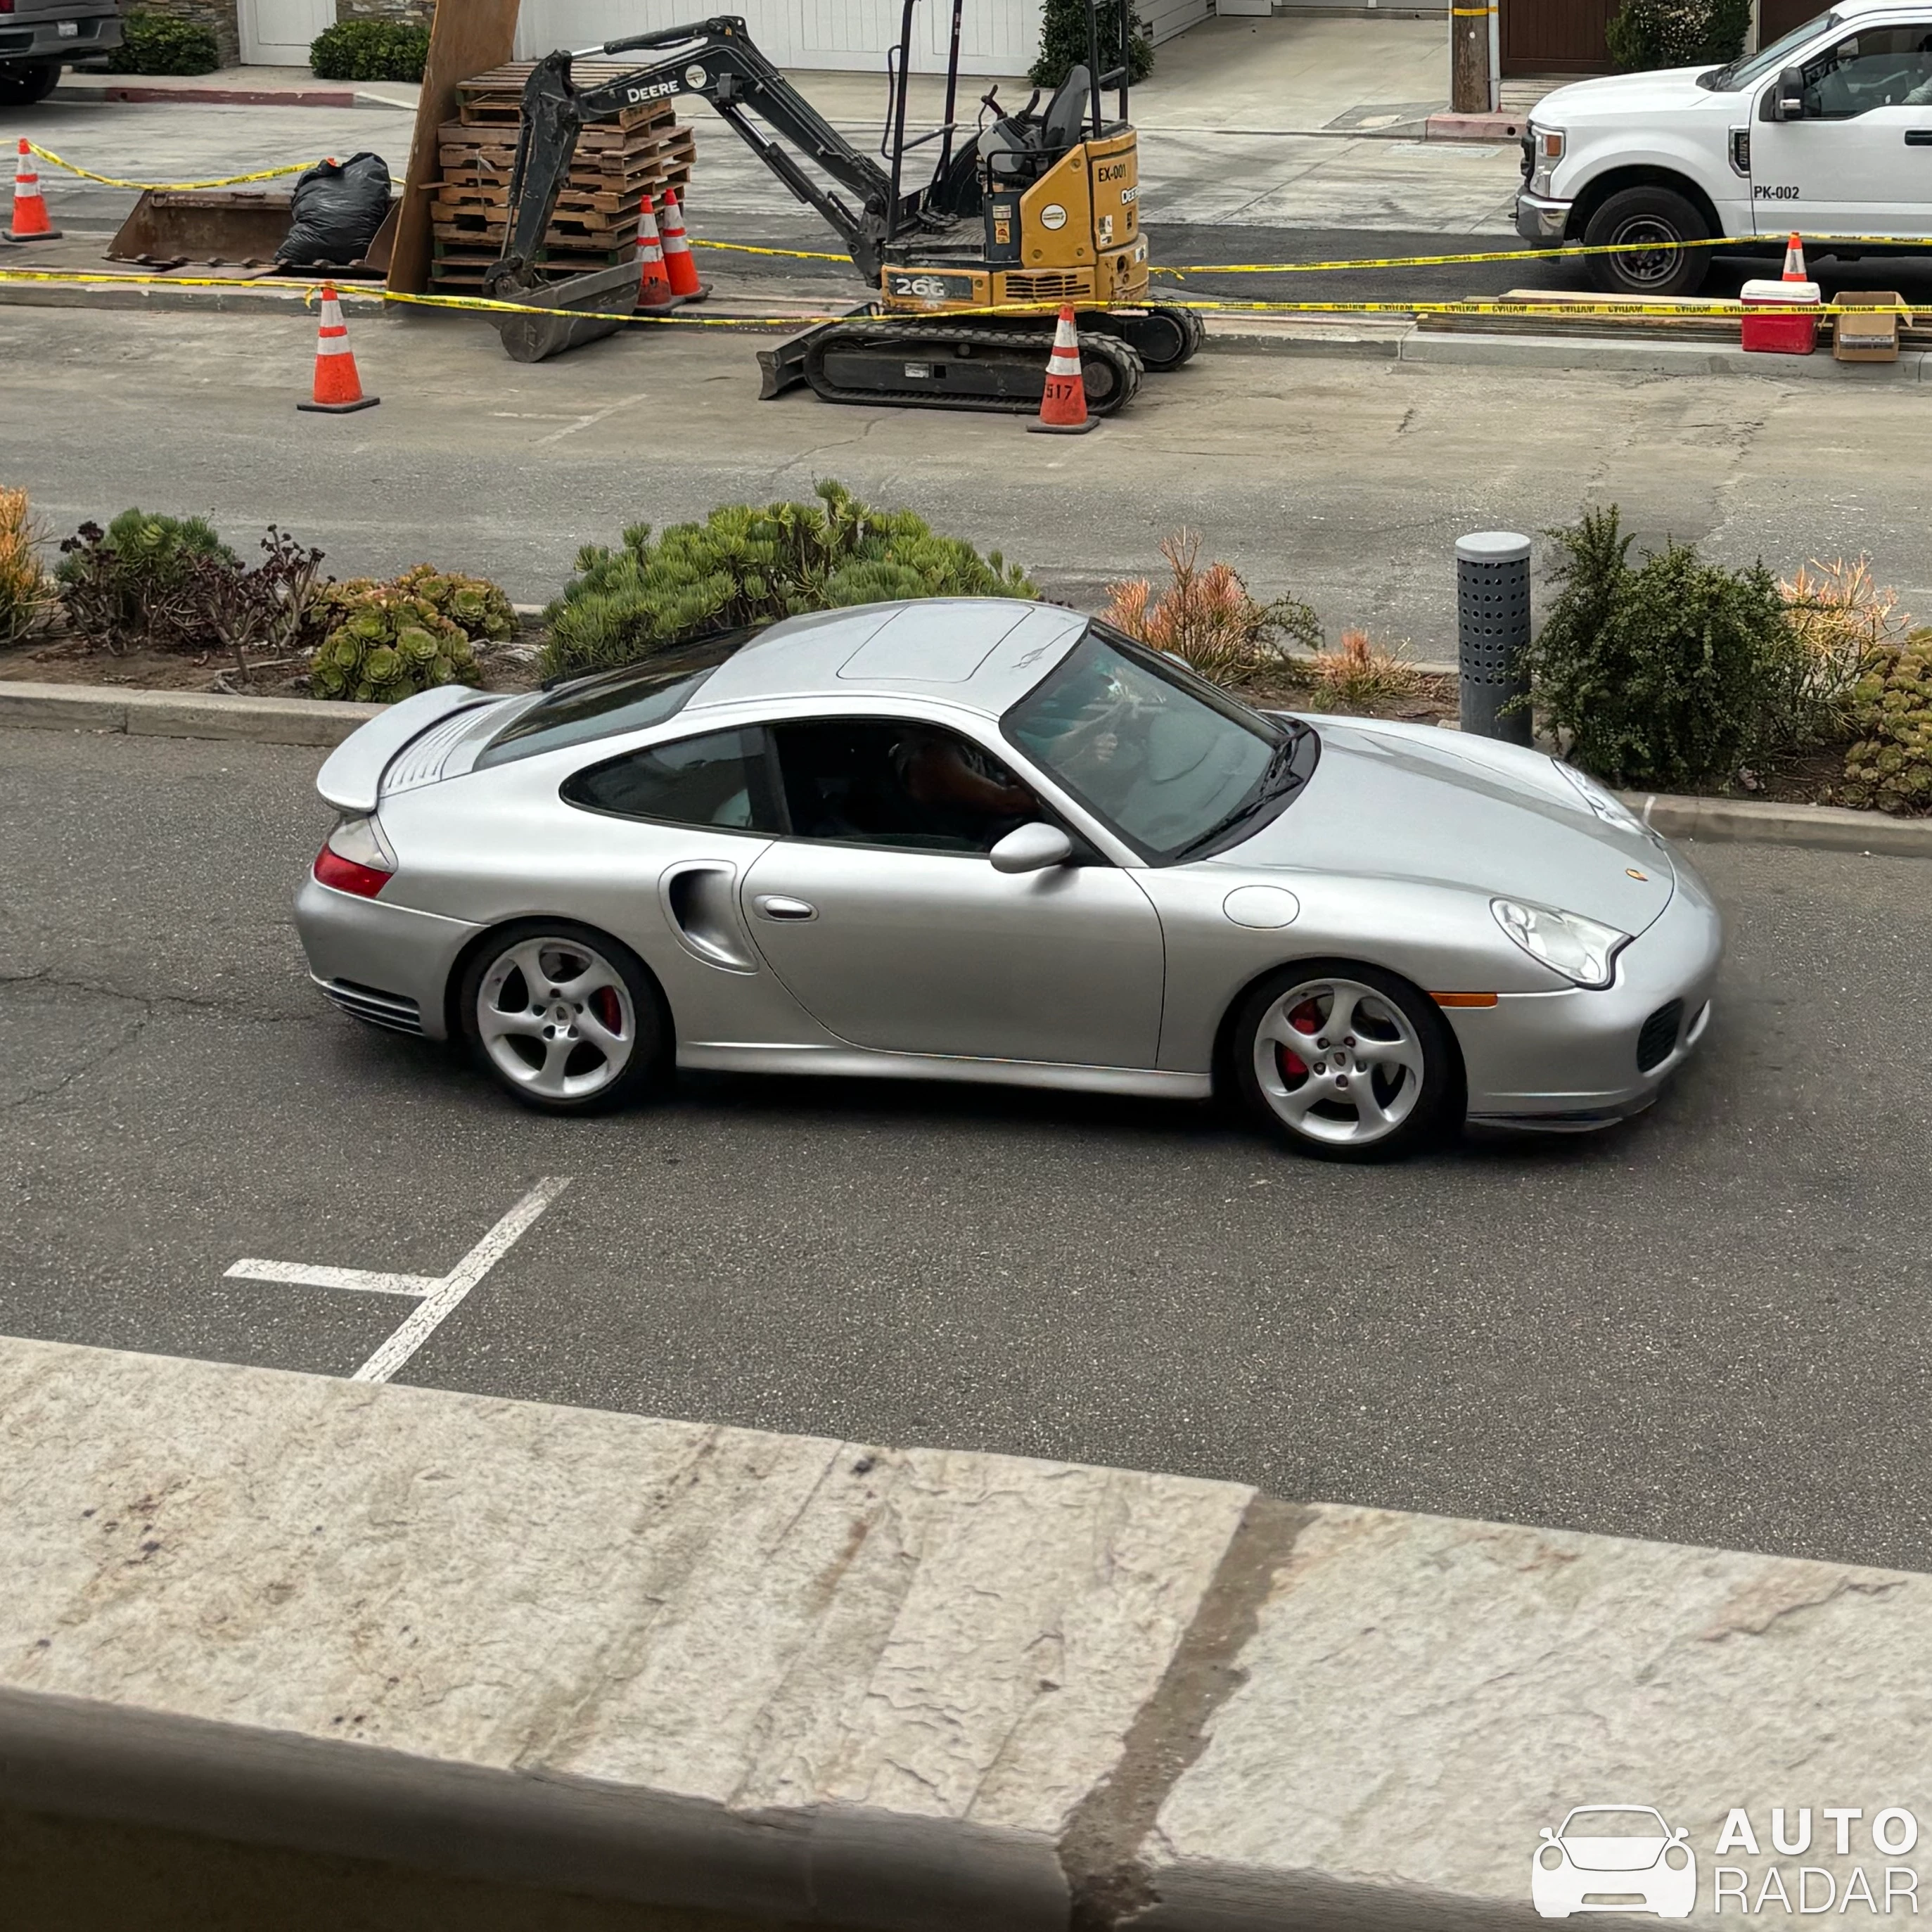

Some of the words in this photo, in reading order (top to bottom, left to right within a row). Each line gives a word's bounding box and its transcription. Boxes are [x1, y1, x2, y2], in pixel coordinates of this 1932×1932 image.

[627, 80, 680, 103] DEERE
[1098, 163, 1127, 182] EX-001
[1754, 186, 1800, 200] PK-002
[895, 278, 945, 297] 26G
[1046, 383, 1073, 400] 517
